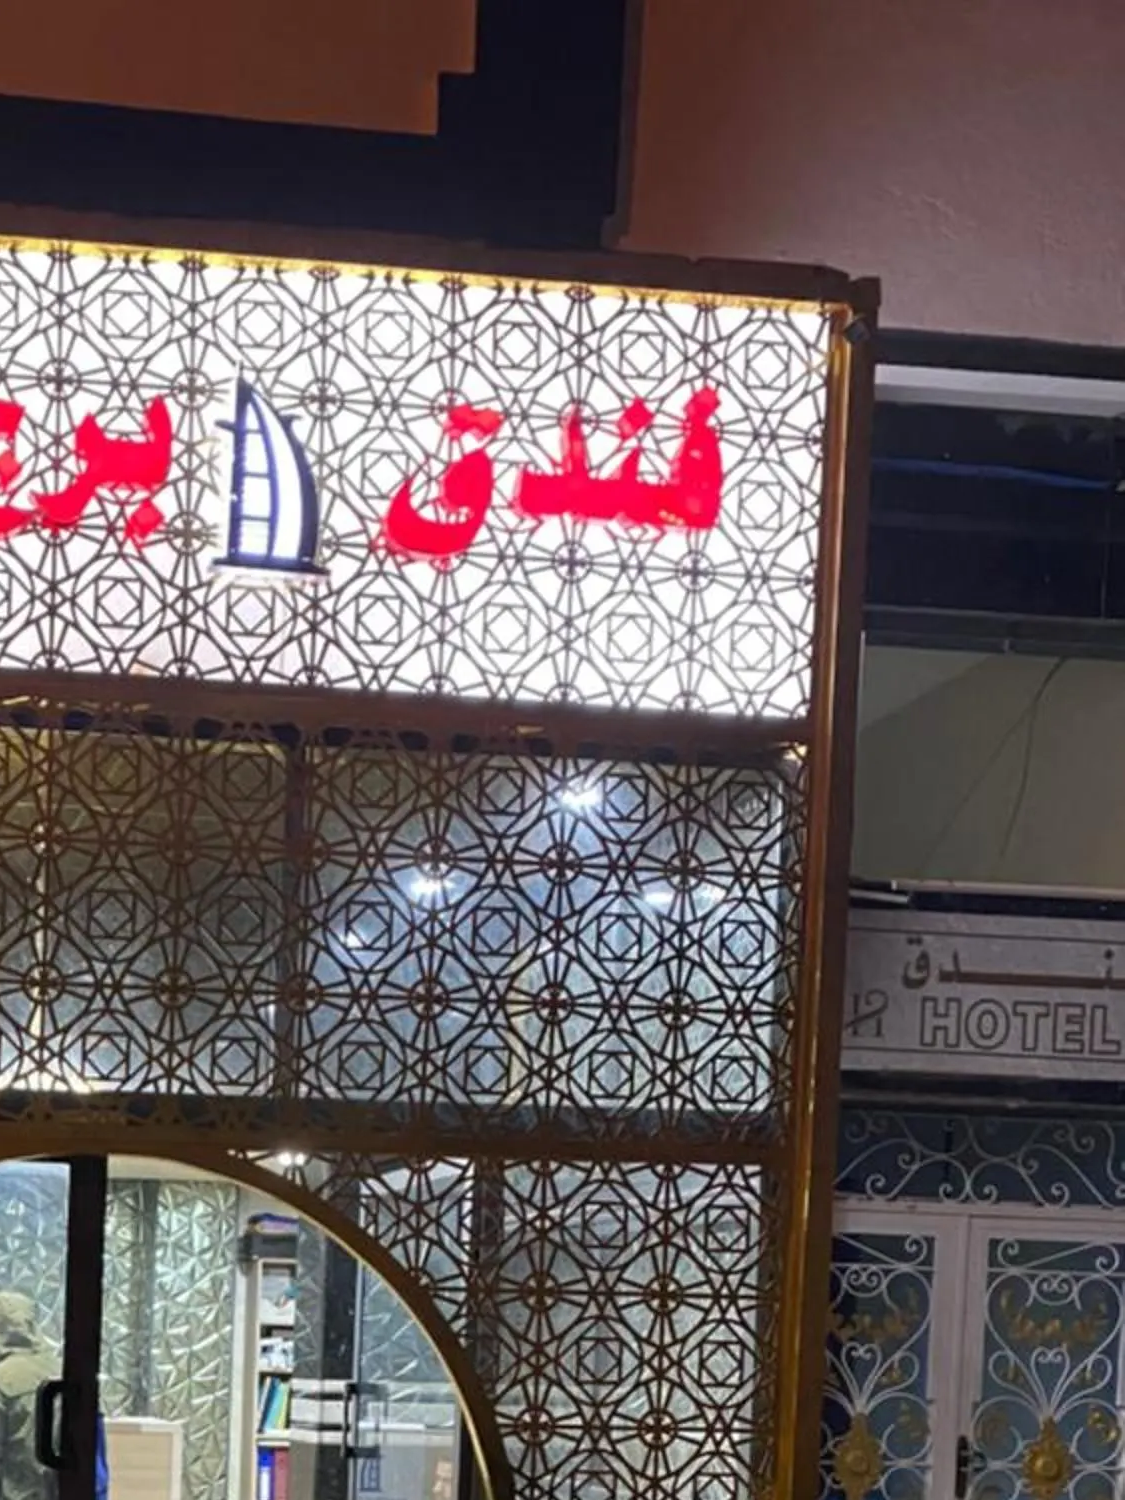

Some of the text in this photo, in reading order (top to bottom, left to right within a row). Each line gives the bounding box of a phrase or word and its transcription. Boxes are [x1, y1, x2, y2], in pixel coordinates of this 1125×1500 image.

[384, 385, 722, 565] فندق
[902, 937, 1125, 991] ندق
[920, 996, 1122, 1055] HOTEL
